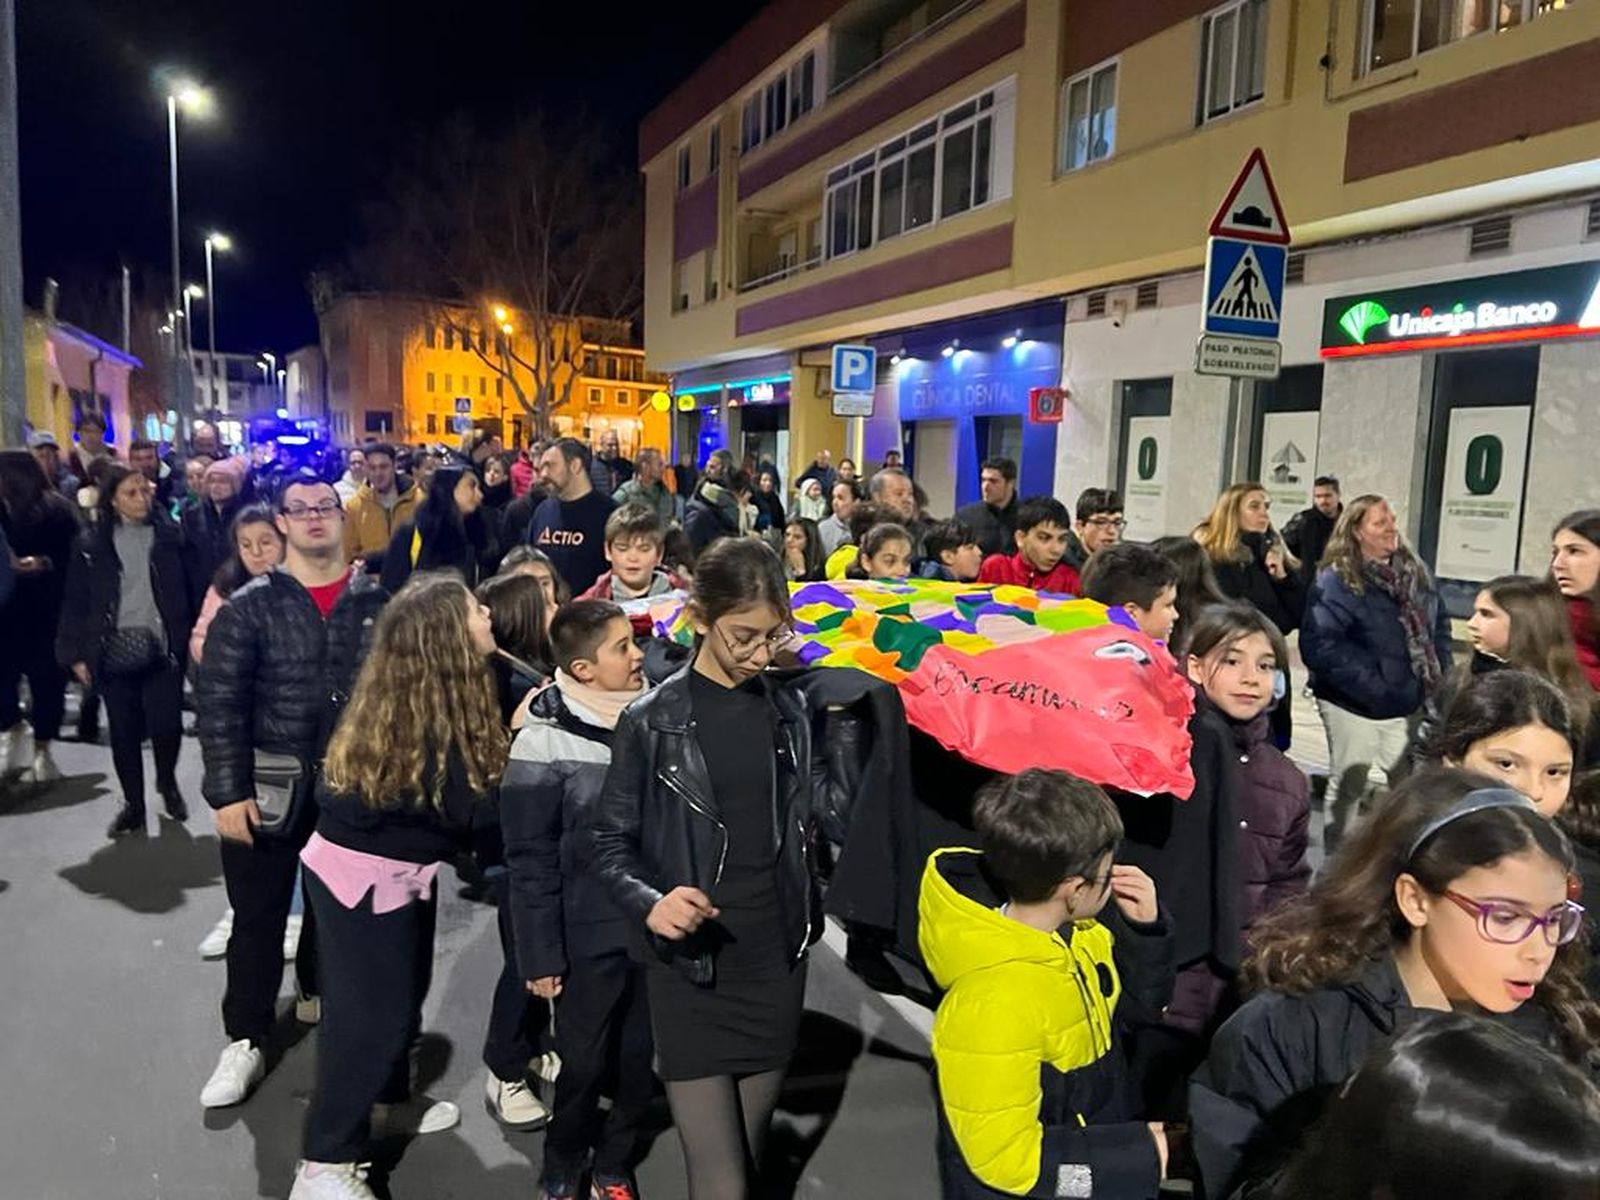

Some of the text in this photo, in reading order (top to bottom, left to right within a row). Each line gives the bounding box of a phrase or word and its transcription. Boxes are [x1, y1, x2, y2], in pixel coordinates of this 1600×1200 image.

[1389, 301, 1558, 336] Unicaja Banco
[1205, 342, 1230, 353] PASO
[841, 350, 868, 387] P
[965, 382, 1018, 406] DENTAL
[538, 526, 584, 545] ACTIO
